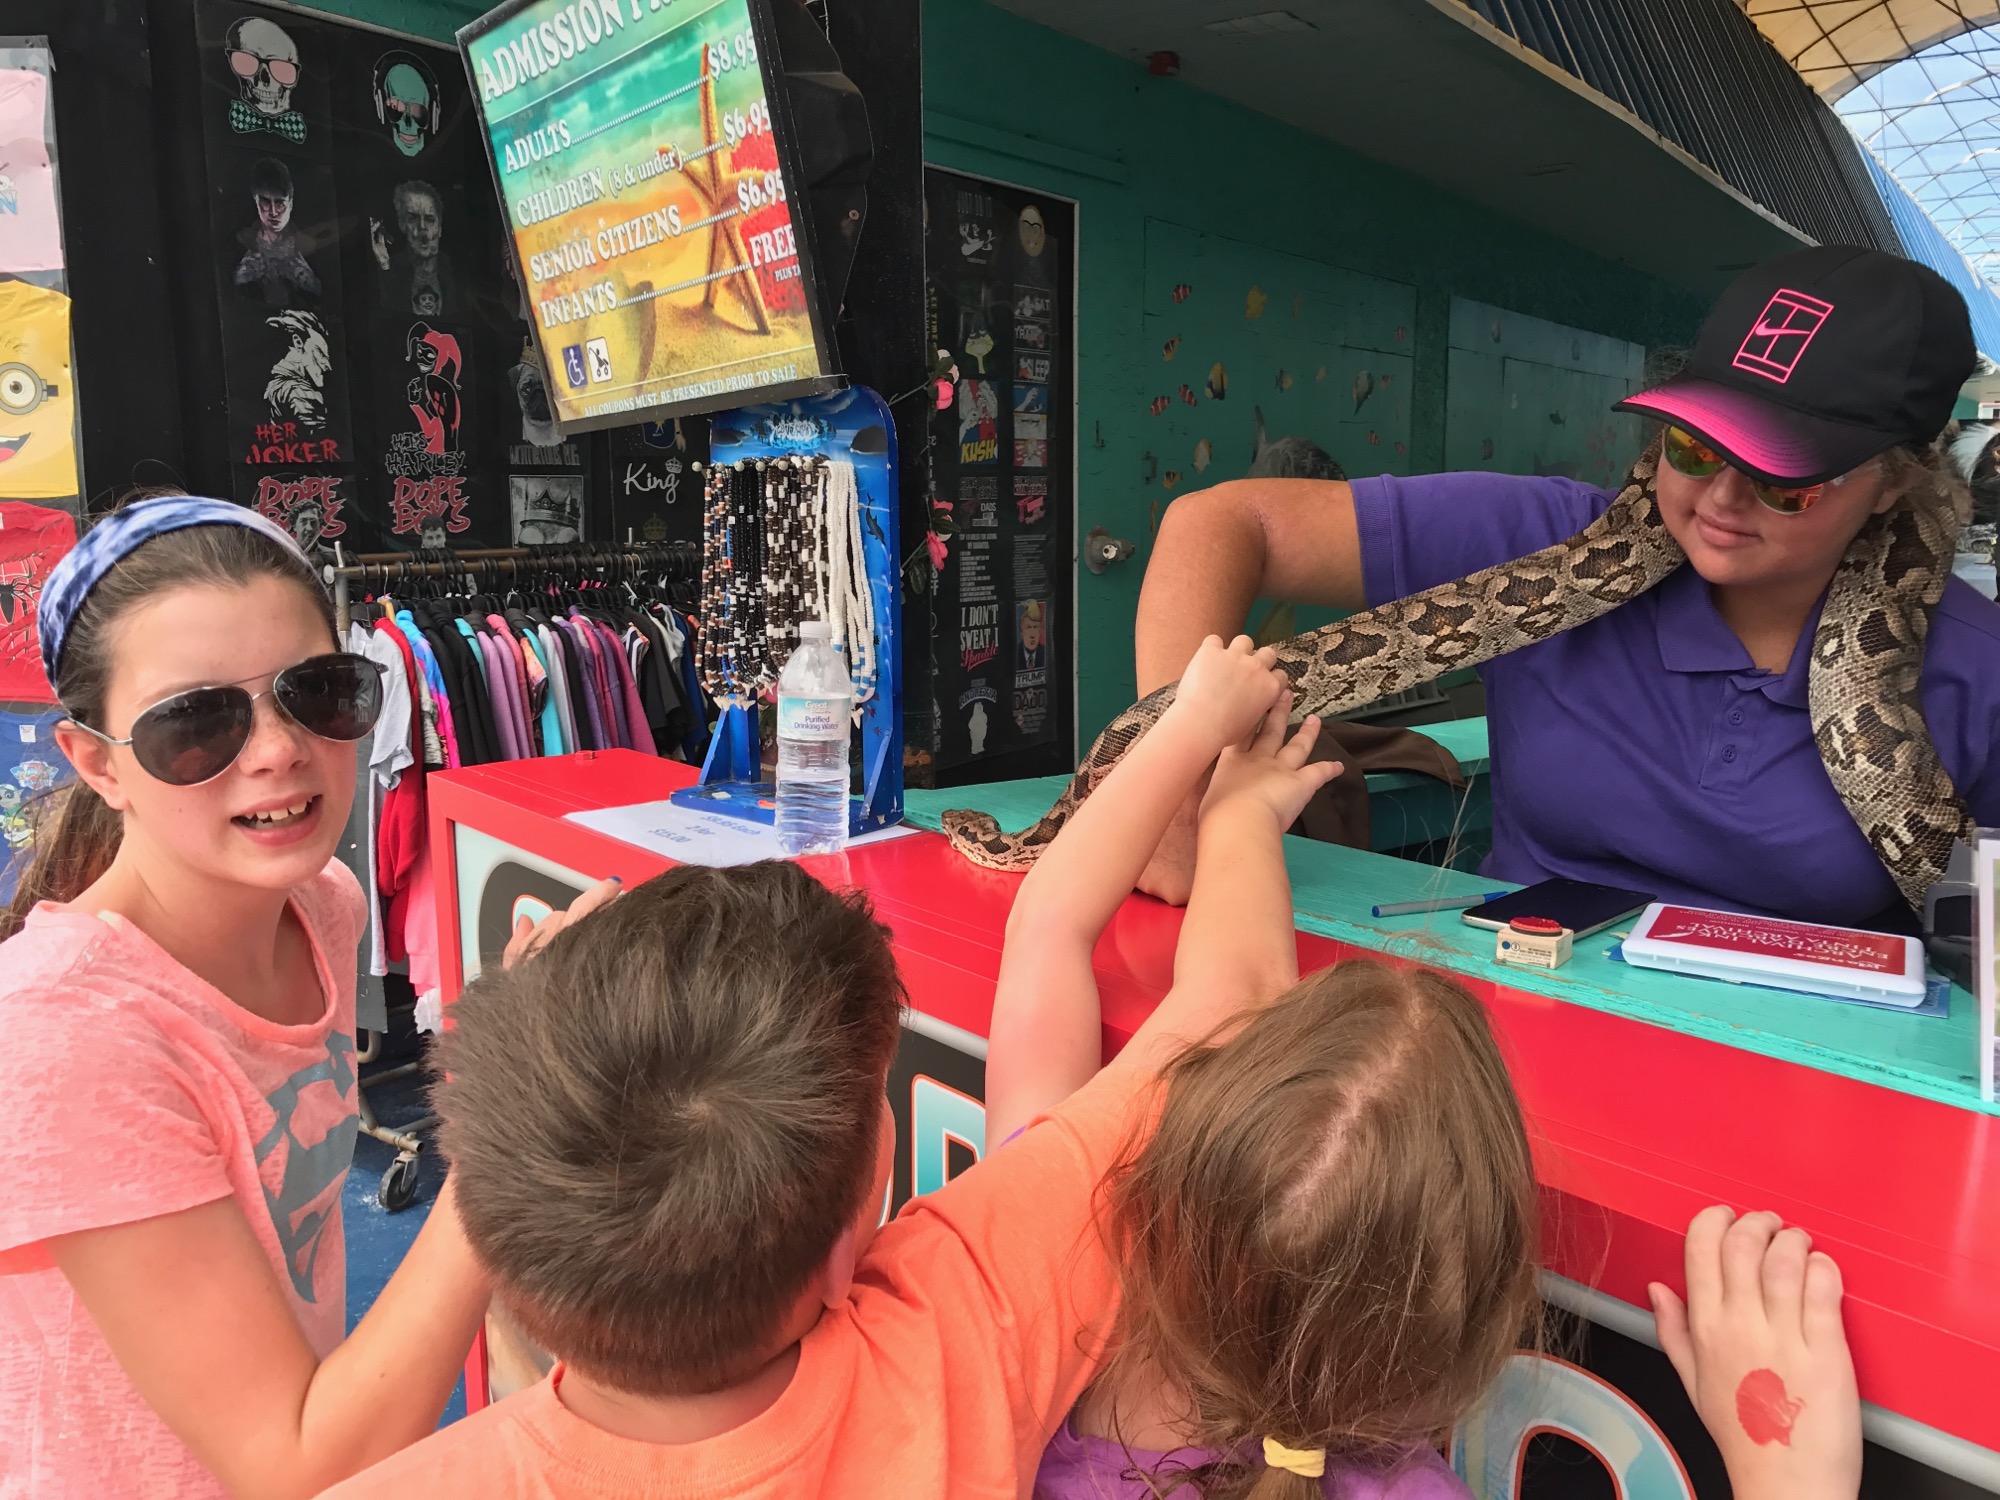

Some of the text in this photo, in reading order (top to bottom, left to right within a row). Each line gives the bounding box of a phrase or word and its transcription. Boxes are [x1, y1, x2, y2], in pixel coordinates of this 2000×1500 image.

[480, 0, 624, 102] ADMISSION
[505, 28, 759, 174] ADULTS $8.95
[516, 168, 605, 227] CHILDREN
[624, 163, 637, 186] &
[636, 143, 683, 182] under)
[530, 168, 787, 283] SENIOR CITIZENS $6.95
[775, 266, 794, 282] PLUS
[540, 281, 618, 328] INFANTS
[584, 364, 797, 418] ALL COUPONS MUST BE PRESENTED PRIOR TO SALE
[256, 422, 299, 444] HER
[391, 432, 429, 452] HIS
[246, 439, 341, 464] JOKER
[385, 450, 466, 475] HARLEY
[960, 438, 996, 464] KUSH
[258, 475, 344, 512] DOPE
[392, 475, 468, 510] DOPE
[623, 462, 680, 504] King
[961, 604, 999, 627] I DON'T
[960, 629, 991, 652] SWEAT
[1016, 671, 1045, 683] TRUMP
[794, 722, 839, 731] Drinking Water
[805, 715, 830, 723] Purified
